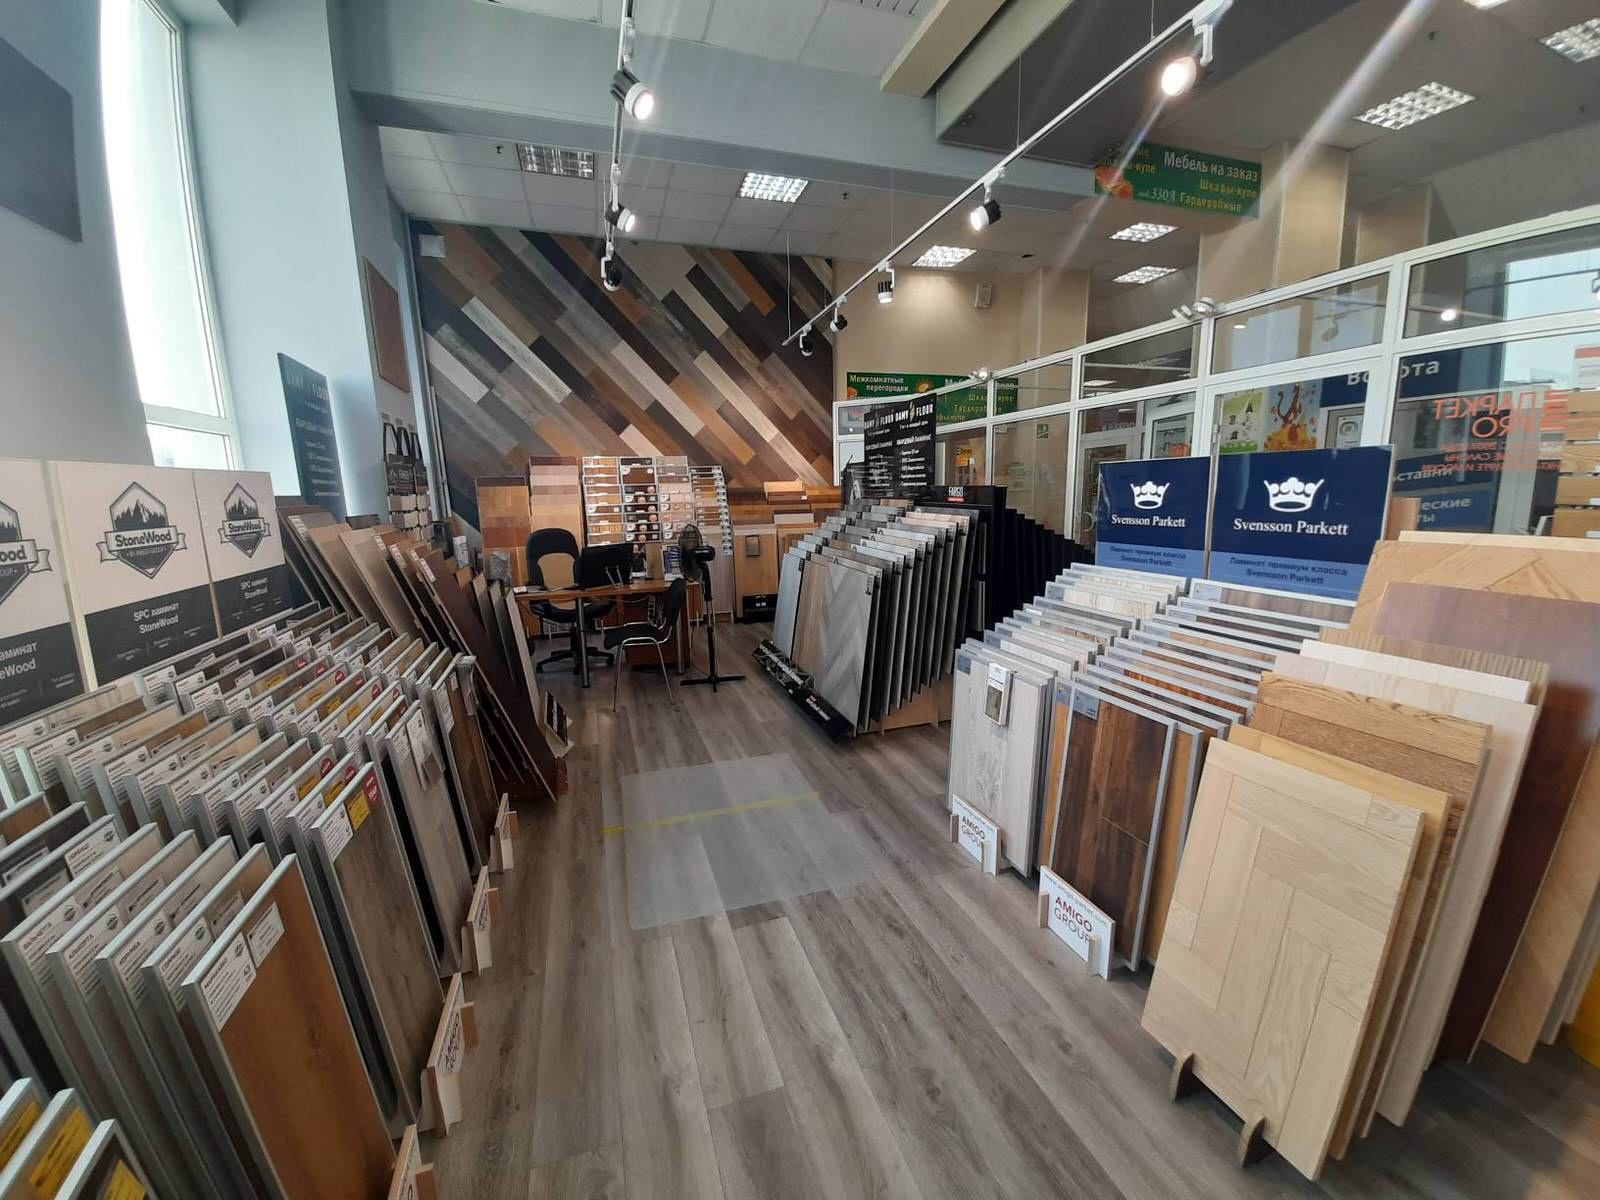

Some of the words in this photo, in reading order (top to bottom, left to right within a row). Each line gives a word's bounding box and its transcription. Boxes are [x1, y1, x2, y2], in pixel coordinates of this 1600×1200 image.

[1164, 151, 1208, 173] Мебель
[1210, 161, 1224, 175] на
[1227, 165, 1258, 182] заказ
[1179, 192, 1242, 212] Гардеробные
[849, 374, 904, 384] Межкомнатные
[916, 404, 933, 416] FLOOR
[880, 414, 894, 425] FLOOR
[949, 486, 964, 497] FARGO
[228, 520, 262, 534] StoneWood
[1111, 514, 1150, 527] Svensson
[1152, 515, 1186, 528] Parkett
[1233, 518, 1292, 533] Svensson
[1296, 520, 1349, 536] Parkett
[114, 529, 172, 547] StoneWood
[1120, 555, 1148, 565] Svensson
[1149, 558, 1173, 567] Parkett
[1163, 552, 1187, 560] класса
[1229, 557, 1266, 568] Ламинат
[1268, 560, 1309, 573] премиум
[1311, 566, 1348, 576] класса
[240, 581, 251, 590] SPC
[1246, 568, 1288, 581] Svensson
[1289, 571, 1324, 585] Parkett
[133, 609, 150, 622] SPC
[151, 602, 180, 617] ламинат
[139, 615, 179, 634] StoneWood
[0, 641, 38, 661] аминат
[0, 658, 37, 679] eWood
[961, 815, 986, 840] AMIGO
[961, 825, 983, 848] GROU
[1055, 896, 1093, 933] AMIGO
